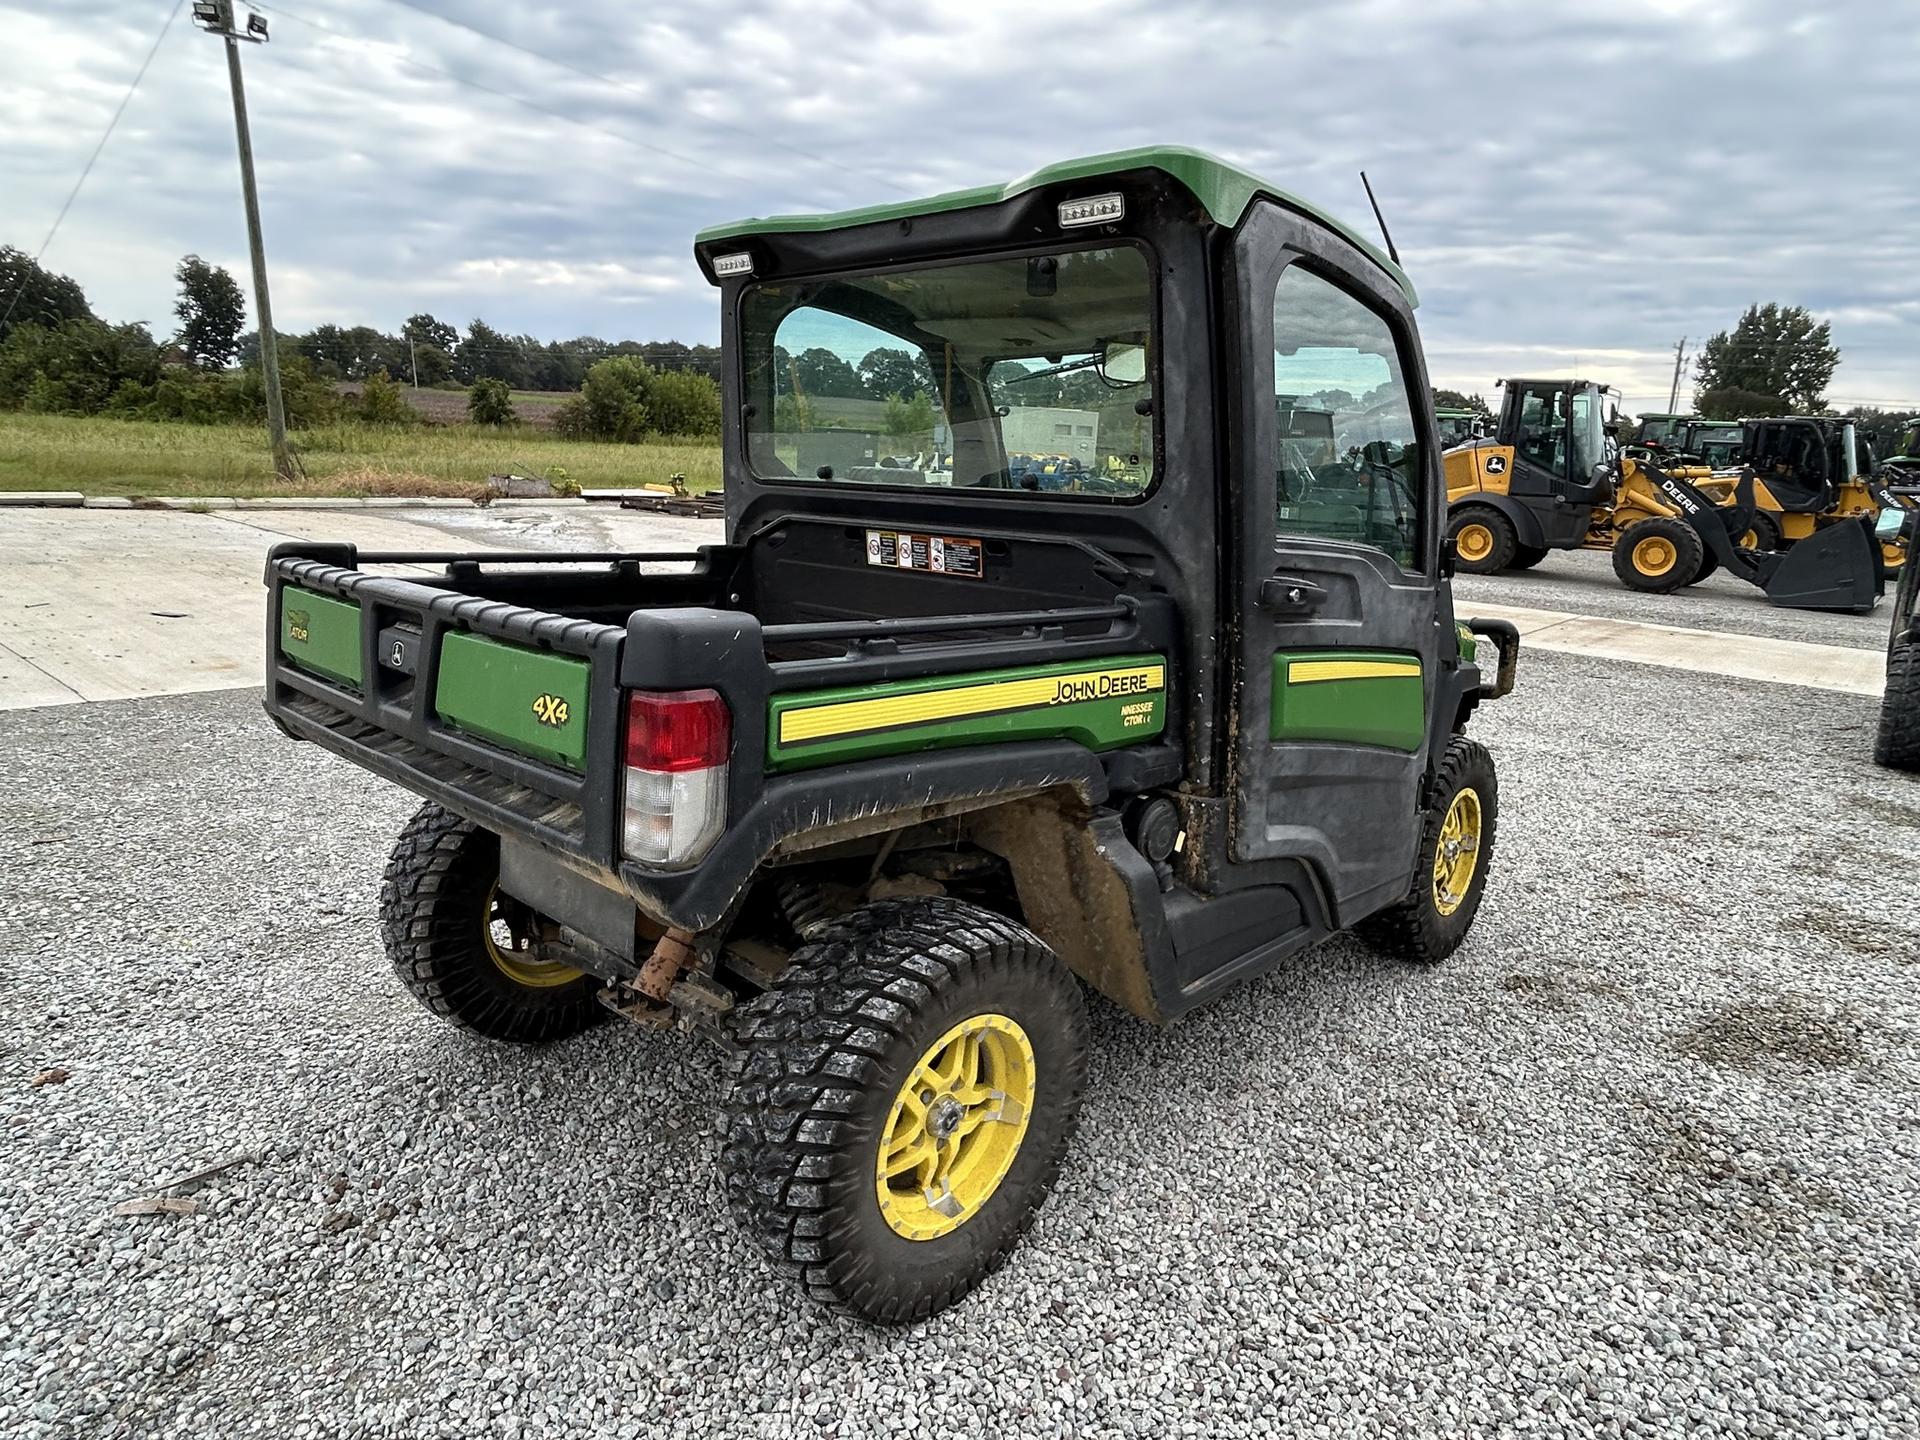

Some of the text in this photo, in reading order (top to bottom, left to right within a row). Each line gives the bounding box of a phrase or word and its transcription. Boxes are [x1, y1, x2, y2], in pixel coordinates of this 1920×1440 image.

[1661, 480, 1700, 515] DEERE
[1051, 674, 1148, 702] JOHN DEERE
[1121, 701, 1154, 716] NNESSEE
[1123, 714, 1143, 727] CTOR
